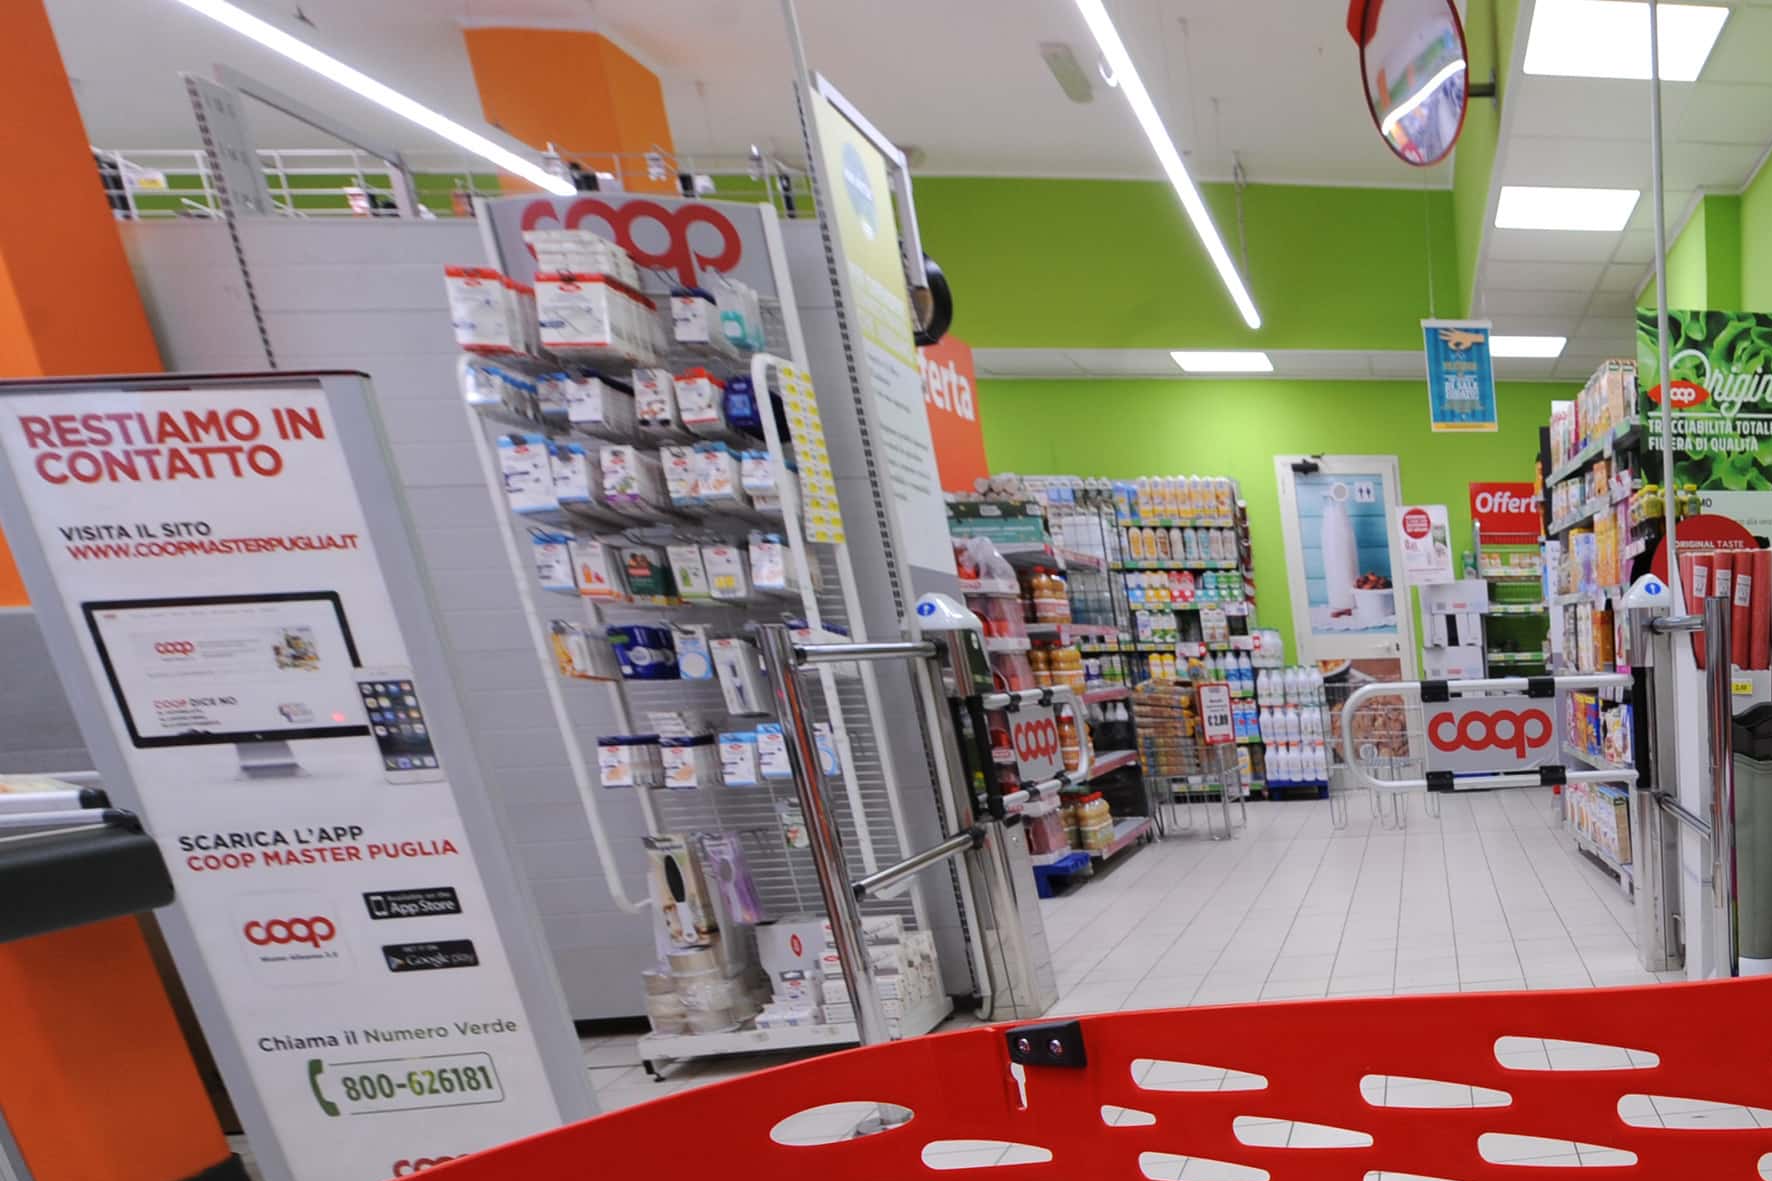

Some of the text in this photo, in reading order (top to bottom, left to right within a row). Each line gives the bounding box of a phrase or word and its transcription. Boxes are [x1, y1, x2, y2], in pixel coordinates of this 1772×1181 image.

[1670, 387, 1697, 403] oop
[18, 407, 326, 450] RESTIAMO IN
[1648, 419, 1733, 435] TRCCIABILITÀ
[1648, 436, 1693, 450] FILERA
[1696, 436, 1708, 449] DI
[34, 444, 284, 486] CONTATTO
[1475, 491, 1538, 513] Offert
[59, 521, 212, 541] VISITA IL SITO
[1717, 540, 1744, 549] TASTE
[1014, 718, 1058, 766] coop
[1427, 708, 1553, 759] coop
[178, 829, 289, 851] SCARICA
[187, 839, 459, 872] COOP MASTER PUGLIA
[390, 898, 457, 917] App Store
[243, 916, 336, 948] coop
[258, 1019, 517, 1052] Chiama il Numero Verde
[341, 1065, 494, 1102] 800-626181
